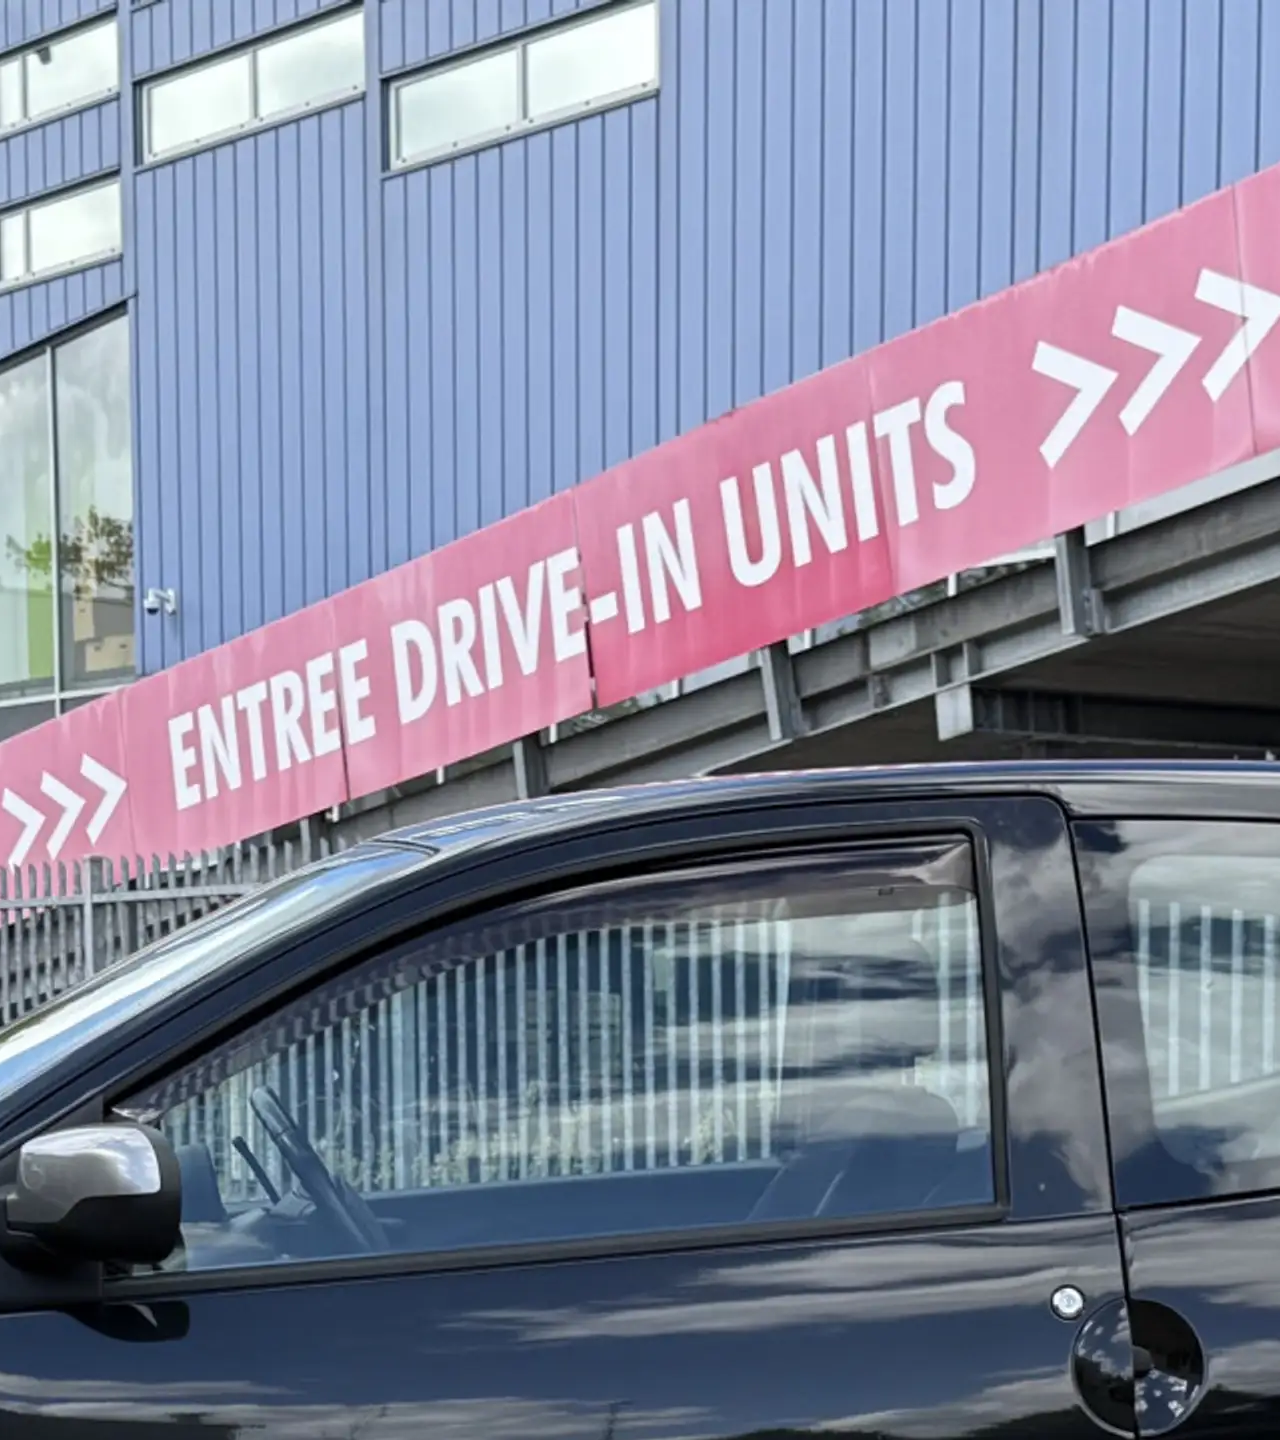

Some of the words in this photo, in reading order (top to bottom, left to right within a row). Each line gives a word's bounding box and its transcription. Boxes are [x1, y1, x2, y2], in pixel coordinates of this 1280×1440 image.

[167, 638, 377, 811] ENTREE
[390, 498, 703, 725] DRIVE-IN
[719, 380, 976, 588] UNITS
